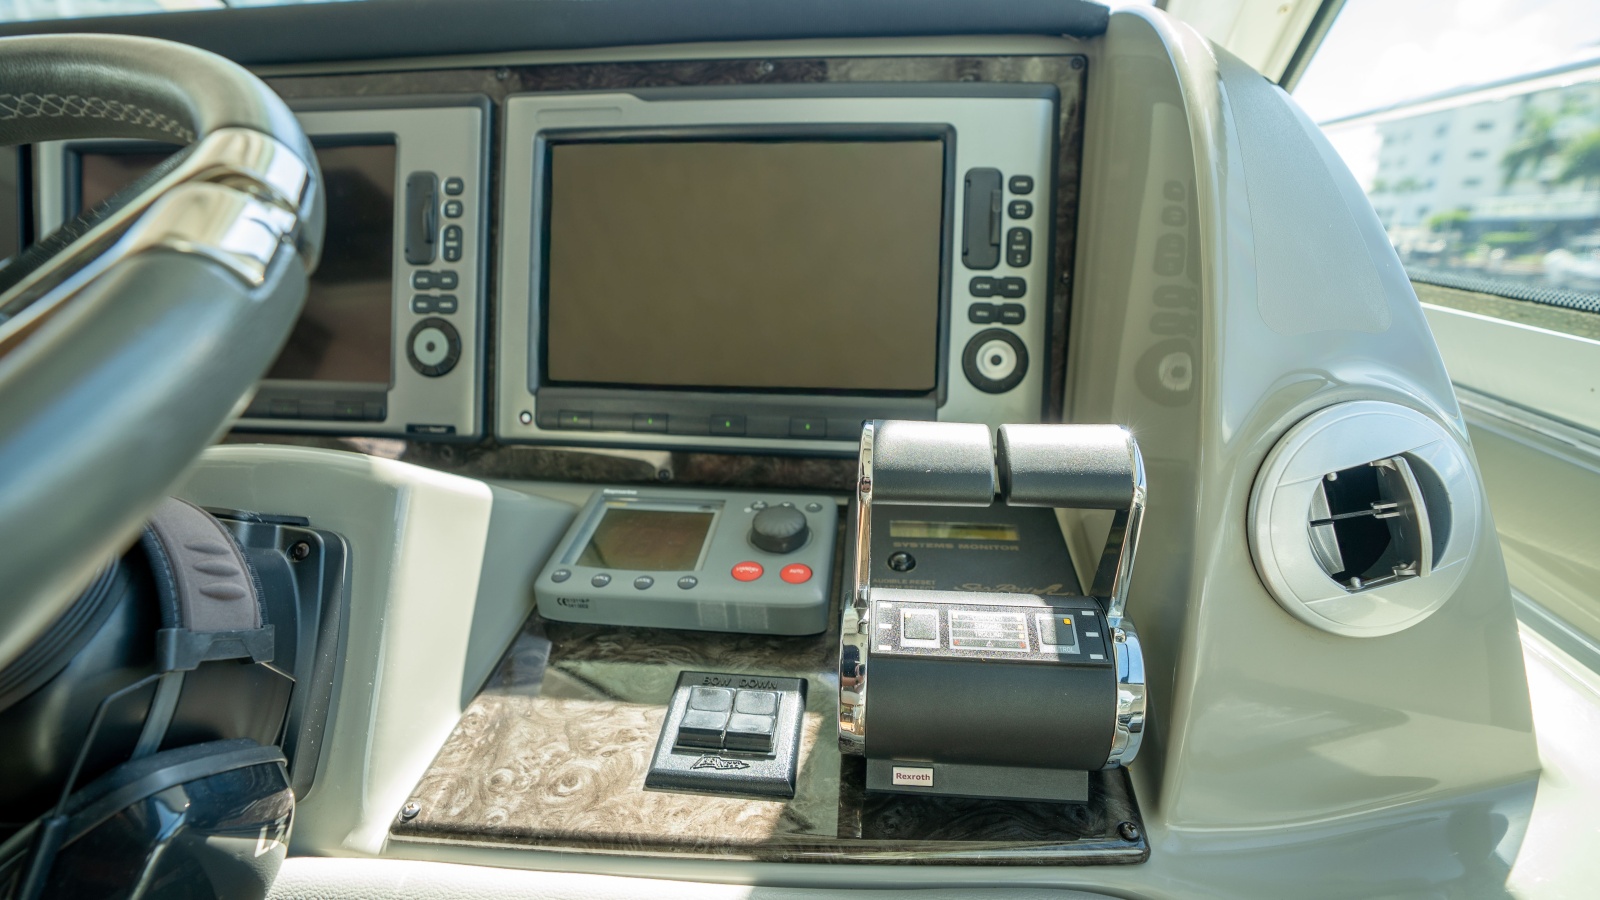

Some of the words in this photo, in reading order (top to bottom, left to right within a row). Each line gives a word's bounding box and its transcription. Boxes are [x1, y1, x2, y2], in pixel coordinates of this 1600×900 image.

[892, 541, 955, 549] SYSTEMS
[957, 543, 1020, 551] MONITOR
[702, 676, 732, 687] BOW
[738, 679, 778, 690] DOWN
[895, 772, 931, 781] Rexroth
